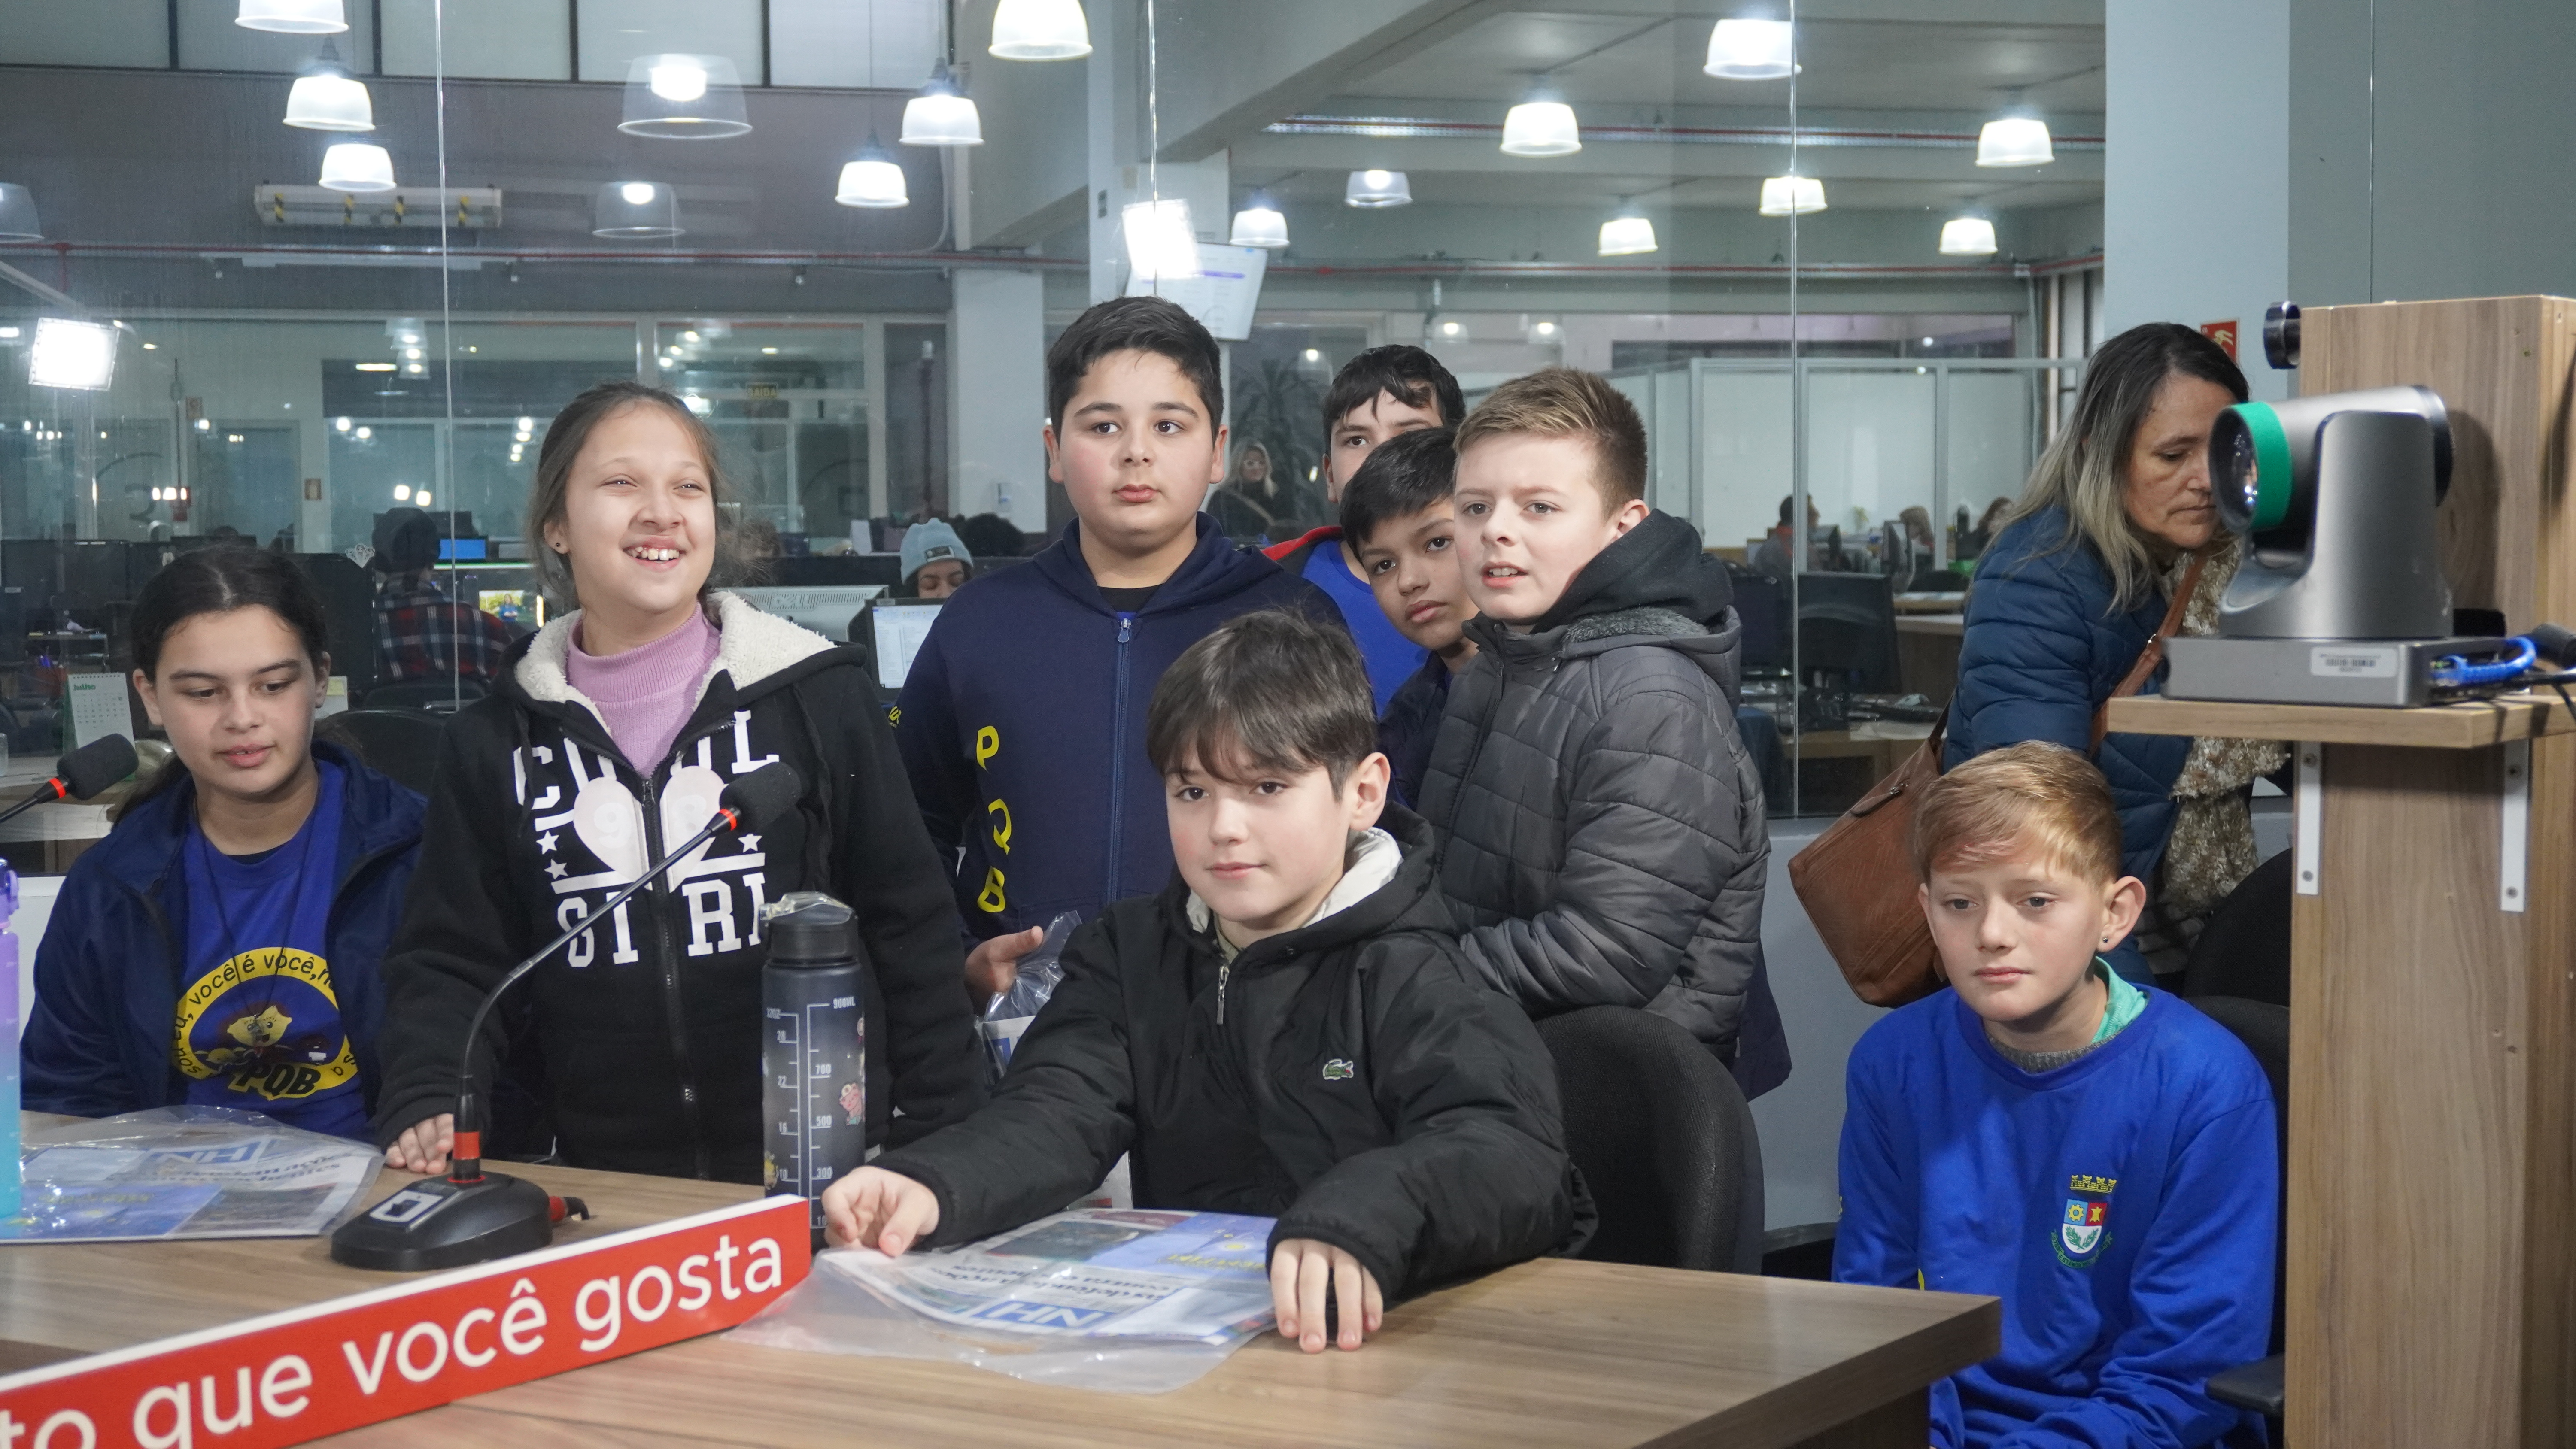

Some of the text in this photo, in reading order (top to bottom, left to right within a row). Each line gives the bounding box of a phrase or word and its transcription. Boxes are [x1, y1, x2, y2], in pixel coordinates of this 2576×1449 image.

[189, 964, 234, 1005] você
[243, 955, 255, 973] é
[833, 996, 856, 1009] 900ML
[815, 1063, 832, 1074] 700
[778, 1075, 787, 1086] 22
[816, 1115, 832, 1126] 500
[779, 1121, 788, 1133] 16
[779, 1168, 788, 1179] 10
[817, 1166, 833, 1178] 300
[817, 1215, 828, 1226] 10
[986, 1302, 1106, 1328] NH
[133, 1354, 312, 1449] que
[343, 1278, 547, 1395] você
[575, 1234, 782, 1351] gosta
